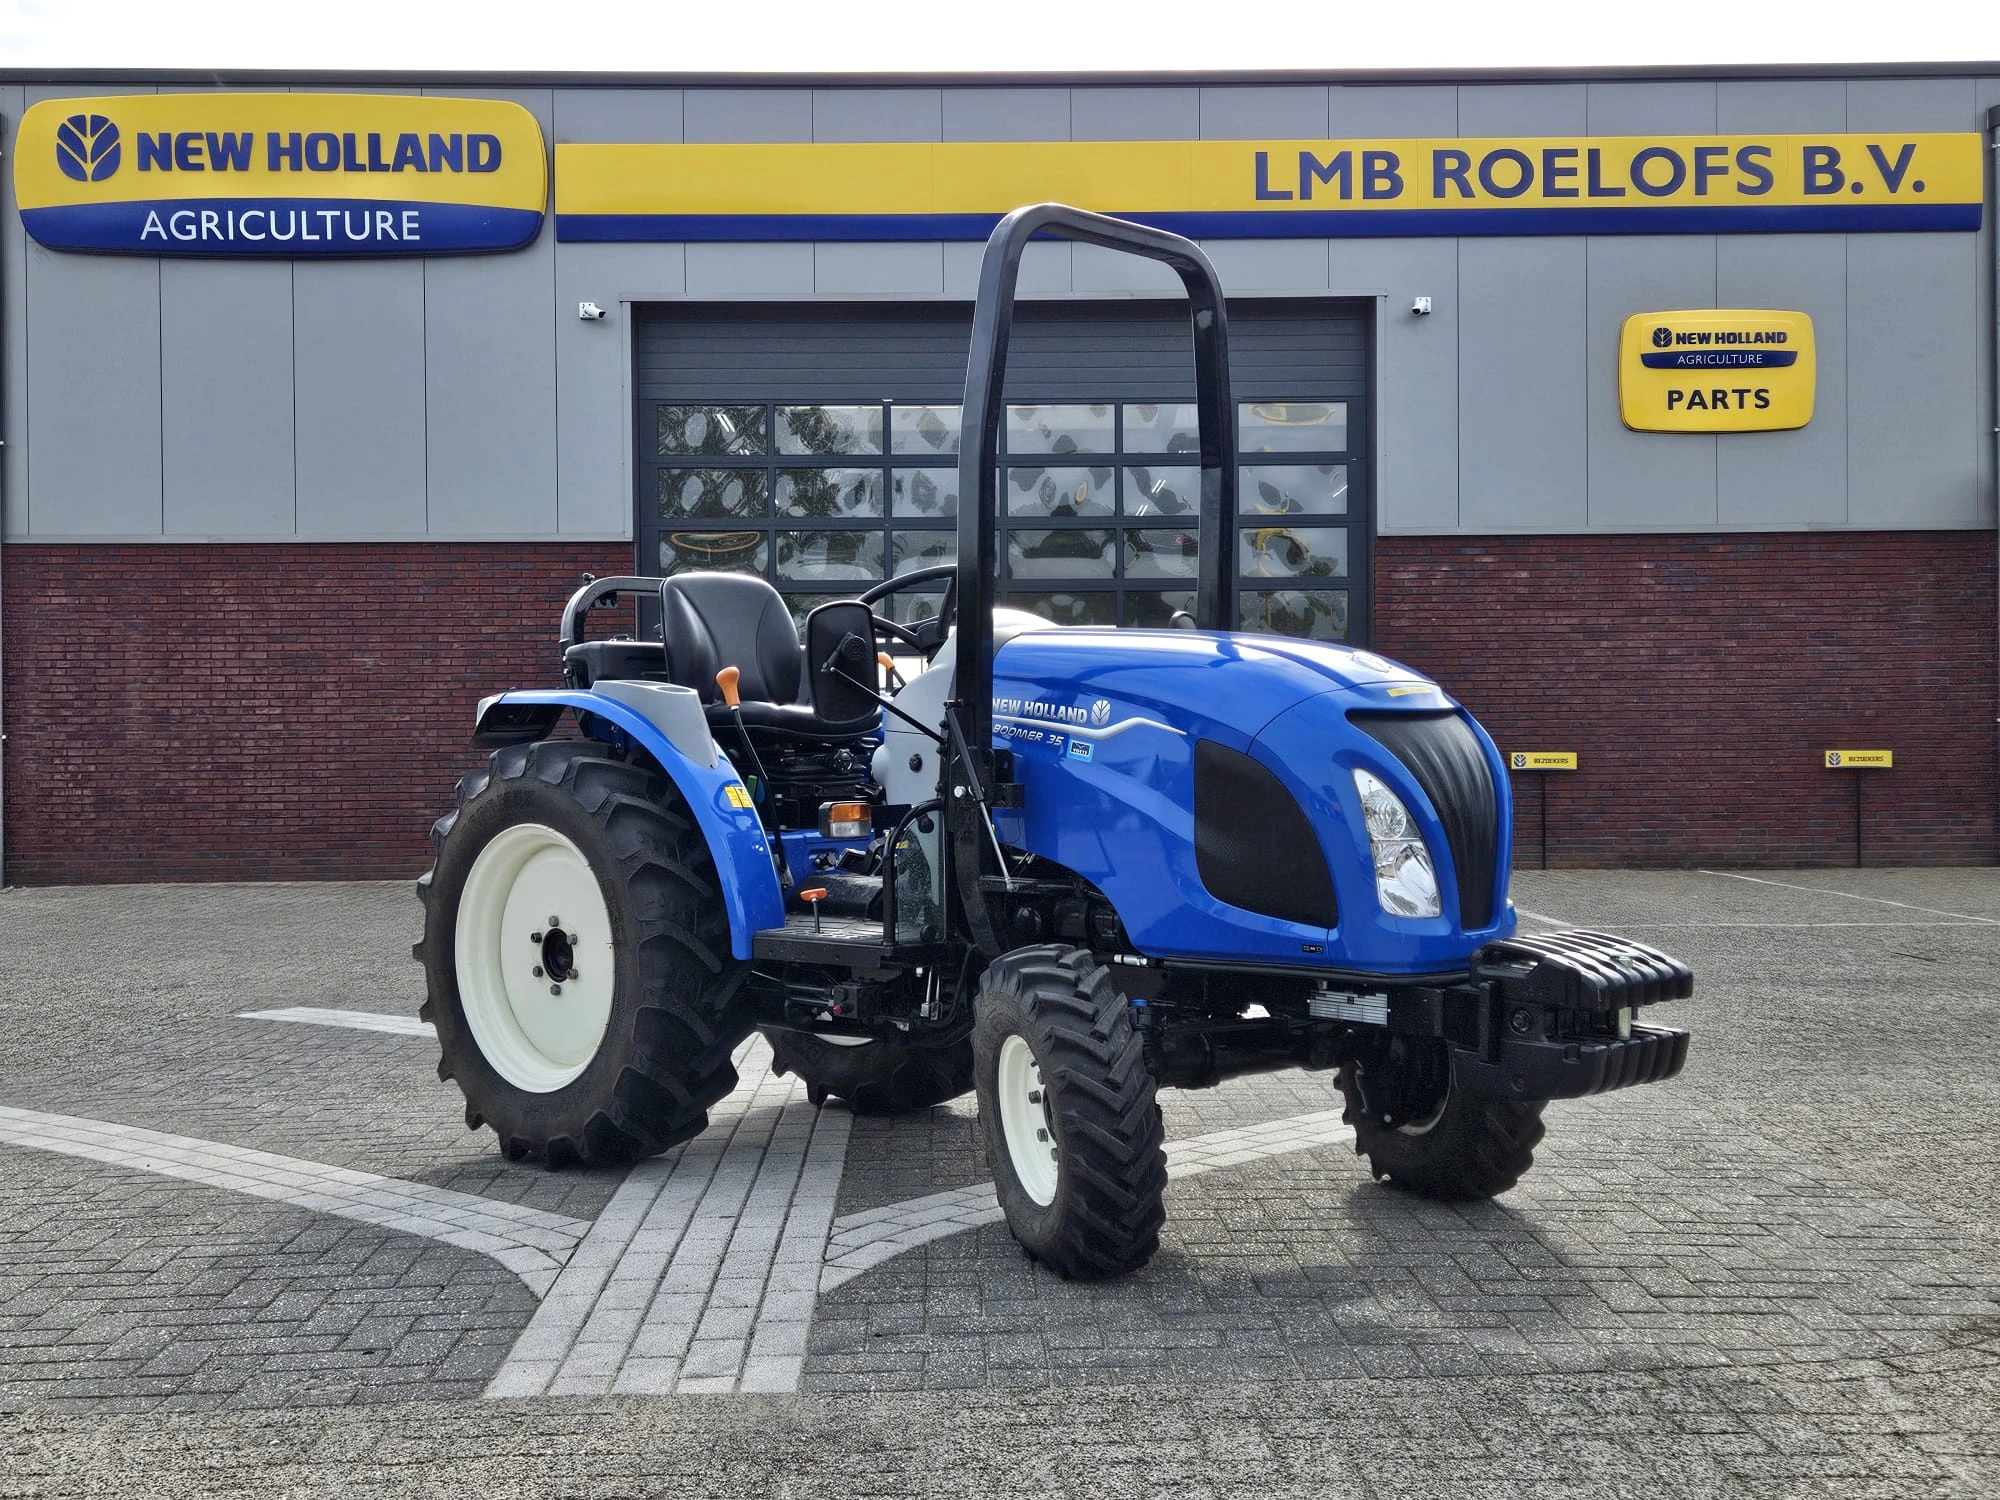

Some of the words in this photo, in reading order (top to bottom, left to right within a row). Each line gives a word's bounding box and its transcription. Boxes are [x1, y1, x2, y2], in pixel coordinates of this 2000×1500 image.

[137, 132, 254, 172] NEW
[267, 132, 501, 173] HOLLAND
[1254, 149, 1405, 201] LMB
[1432, 145, 1775, 199] ROELOFS
[1802, 143, 1926, 196] B.V.
[140, 209, 421, 242] AGRICULTURE
[1675, 332, 1712, 345] NEW
[1714, 331, 1788, 344] HOLLAND
[1677, 353, 1763, 366] AGRICULTURE
[1667, 388, 1771, 411] PARTS
[992, 697, 1022, 714] NEW
[1023, 701, 1088, 724] HOLLAND
[992, 724, 1043, 742] BOOMER
[1046, 734, 1064, 747] 35
